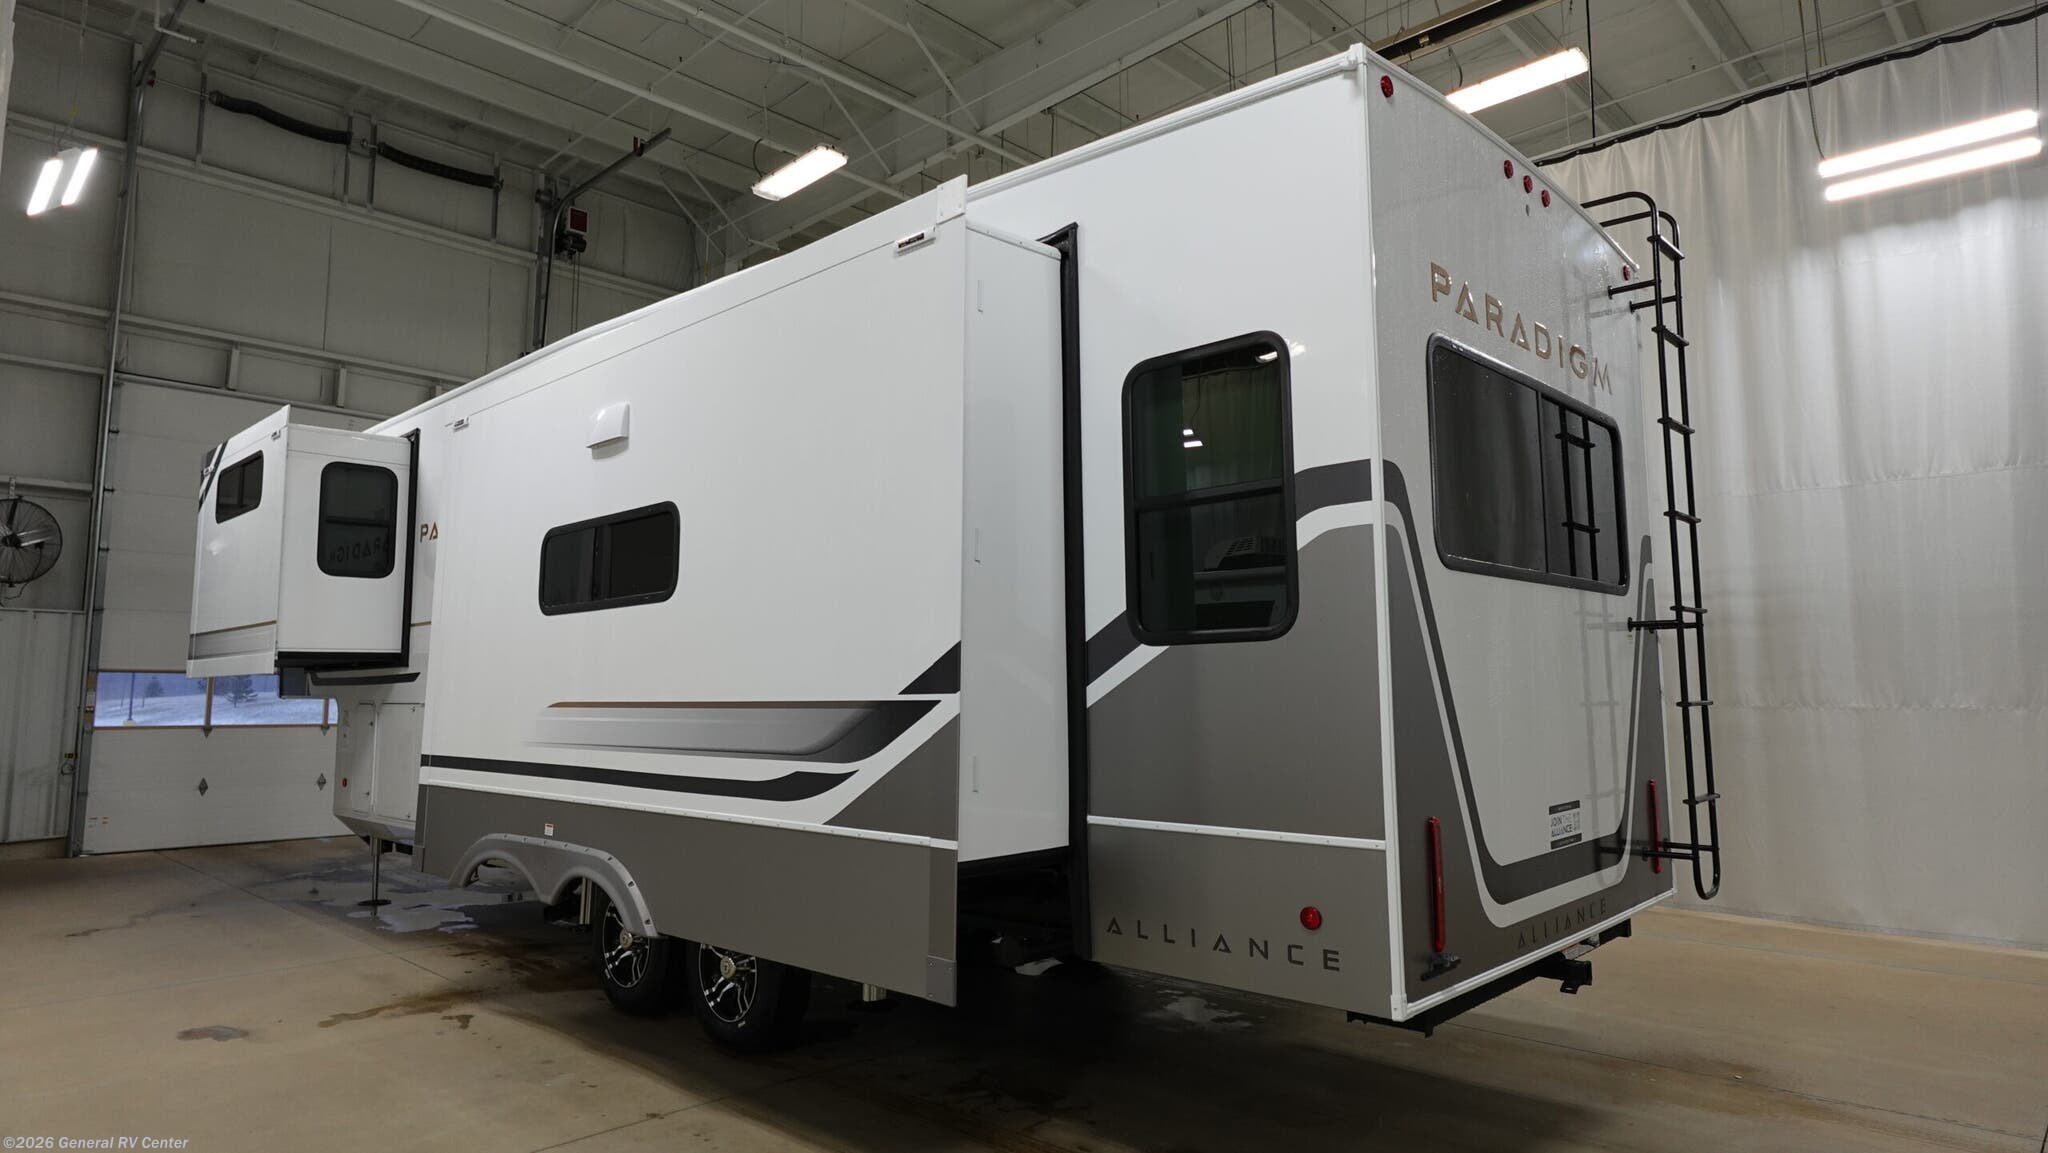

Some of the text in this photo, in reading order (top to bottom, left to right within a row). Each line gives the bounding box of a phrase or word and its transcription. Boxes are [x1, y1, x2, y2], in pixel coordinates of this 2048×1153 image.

[1430, 262, 1613, 396] PARADIGM
[1106, 916, 1340, 971] ALLIANCE
[1518, 897, 1607, 949] ALLIANCE
